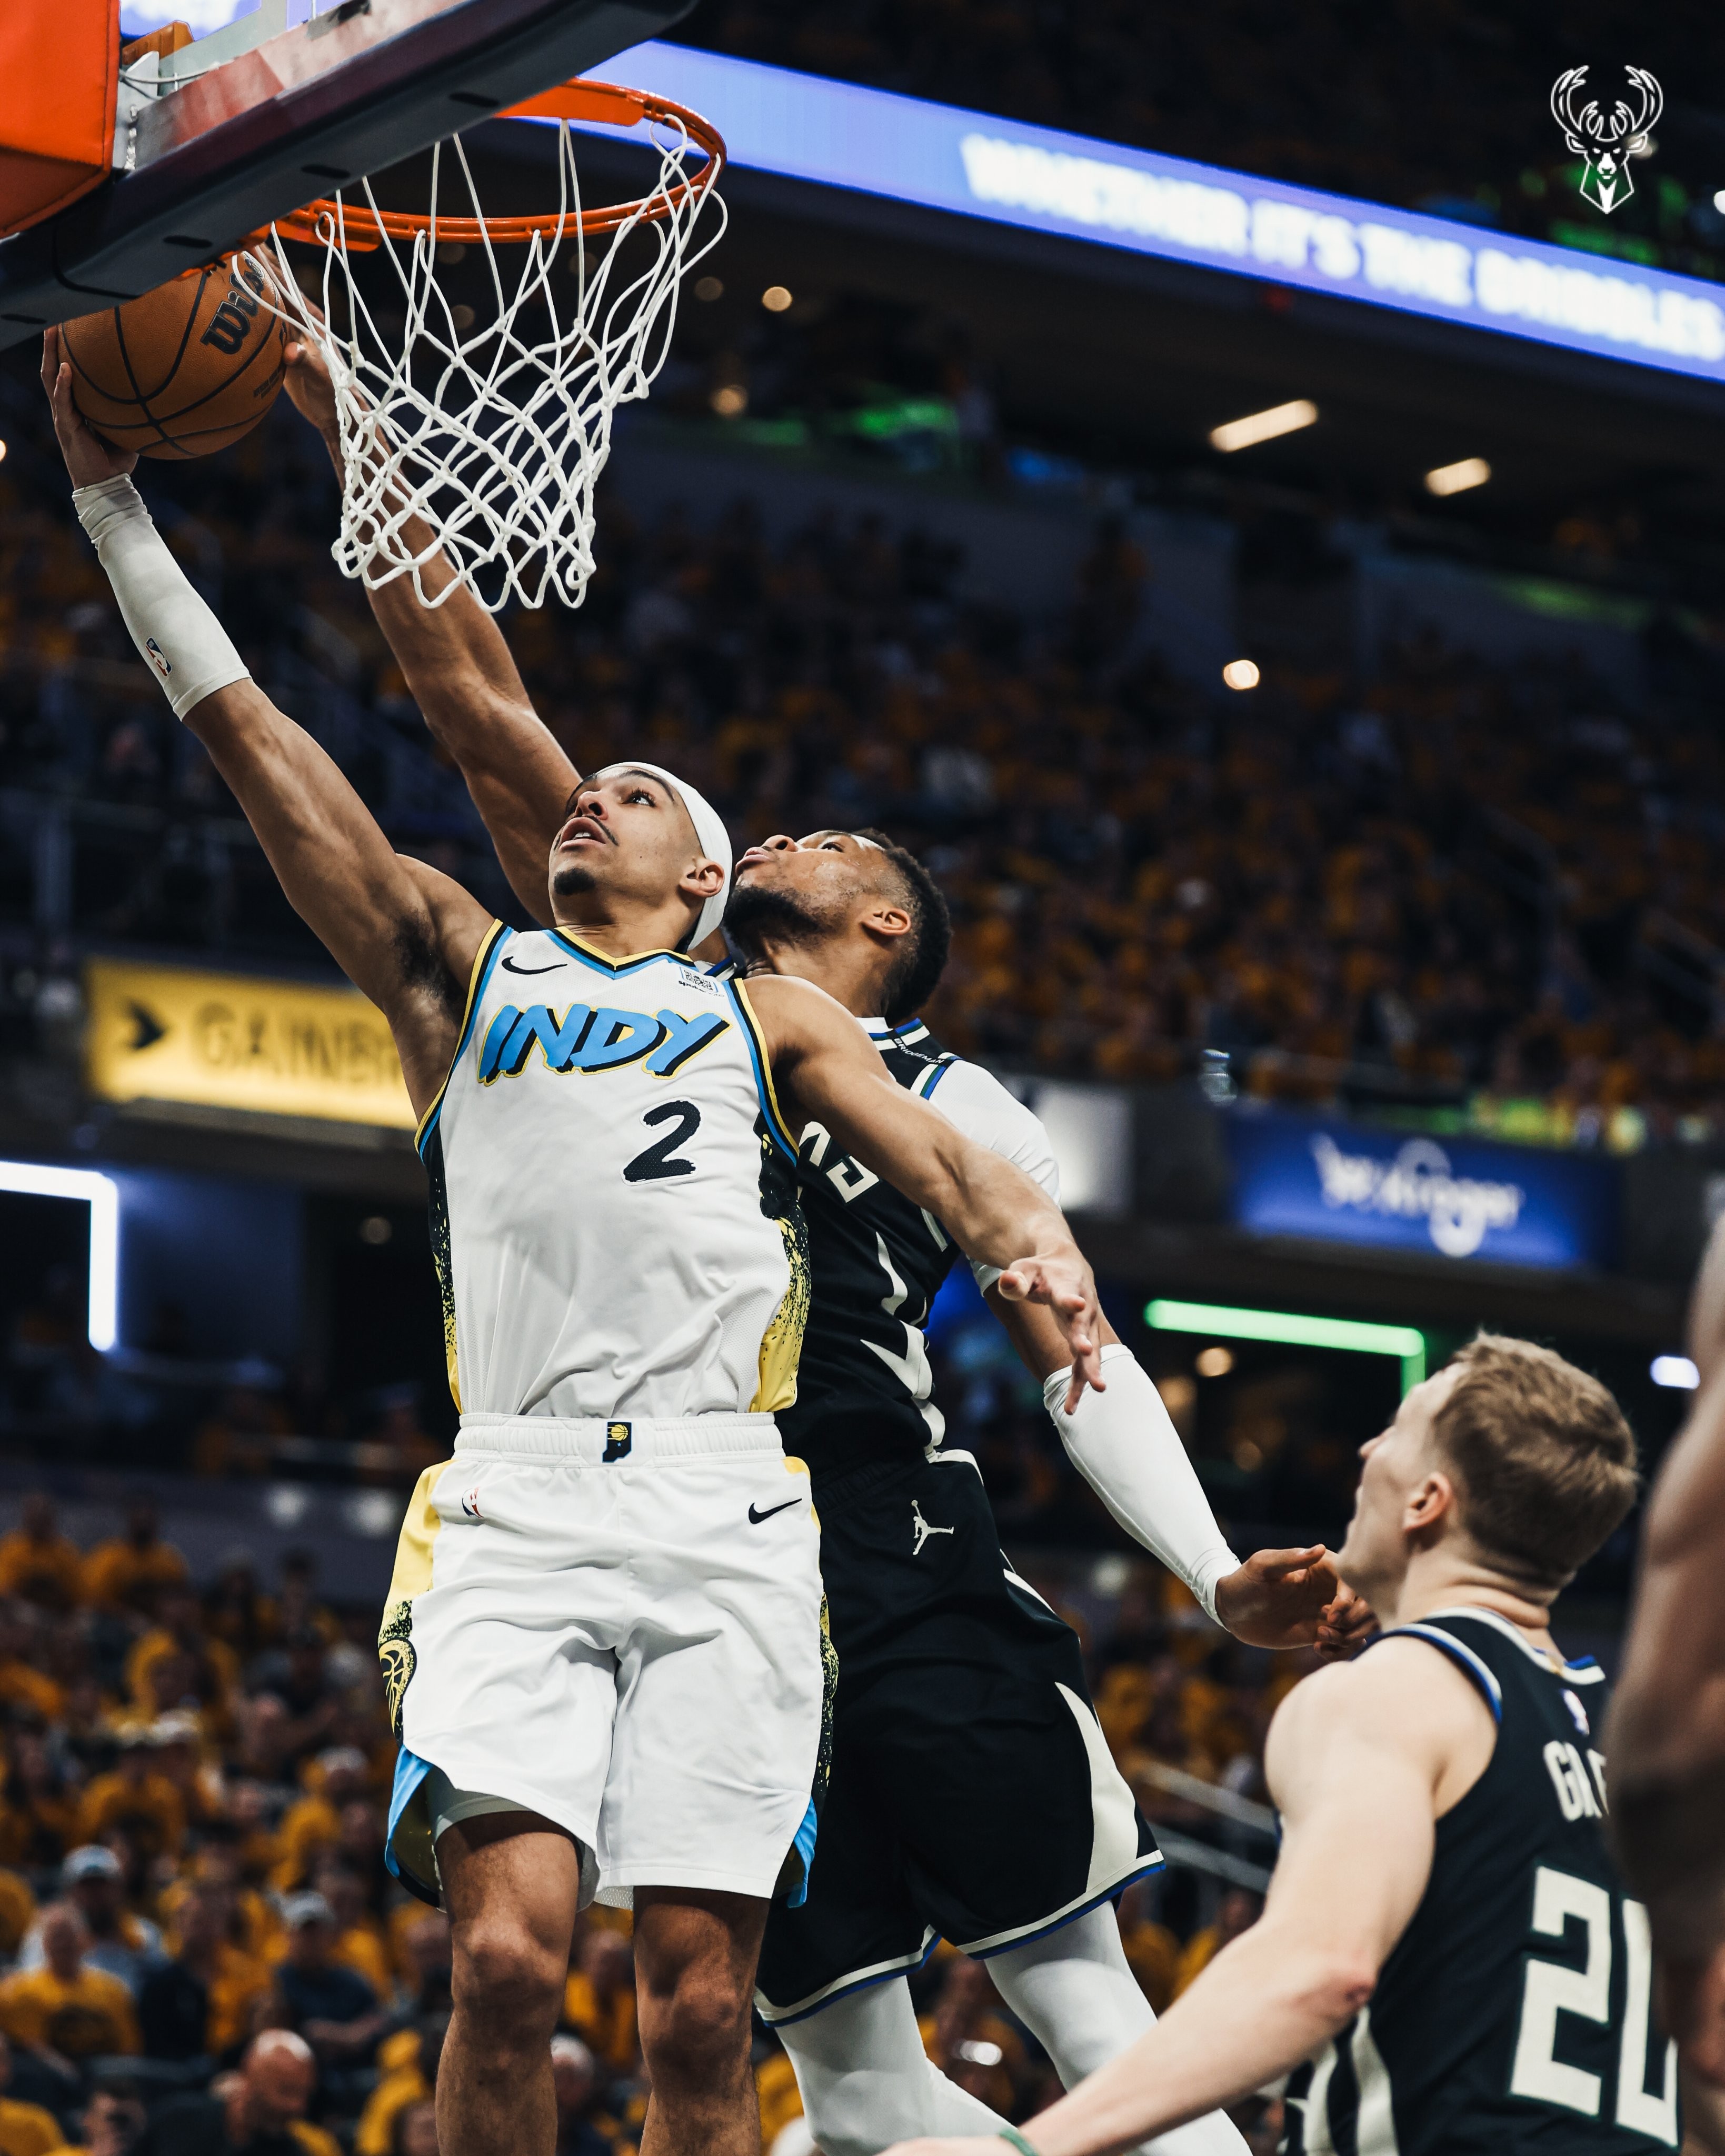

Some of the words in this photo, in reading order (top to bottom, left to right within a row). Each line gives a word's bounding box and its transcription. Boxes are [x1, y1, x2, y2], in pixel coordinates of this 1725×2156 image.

[200, 270, 265, 355] Wils
[477, 1002, 733, 1086] INDY
[894, 1038, 945, 1064] BRIDGEMAN
[621, 1098, 703, 1184] 2
